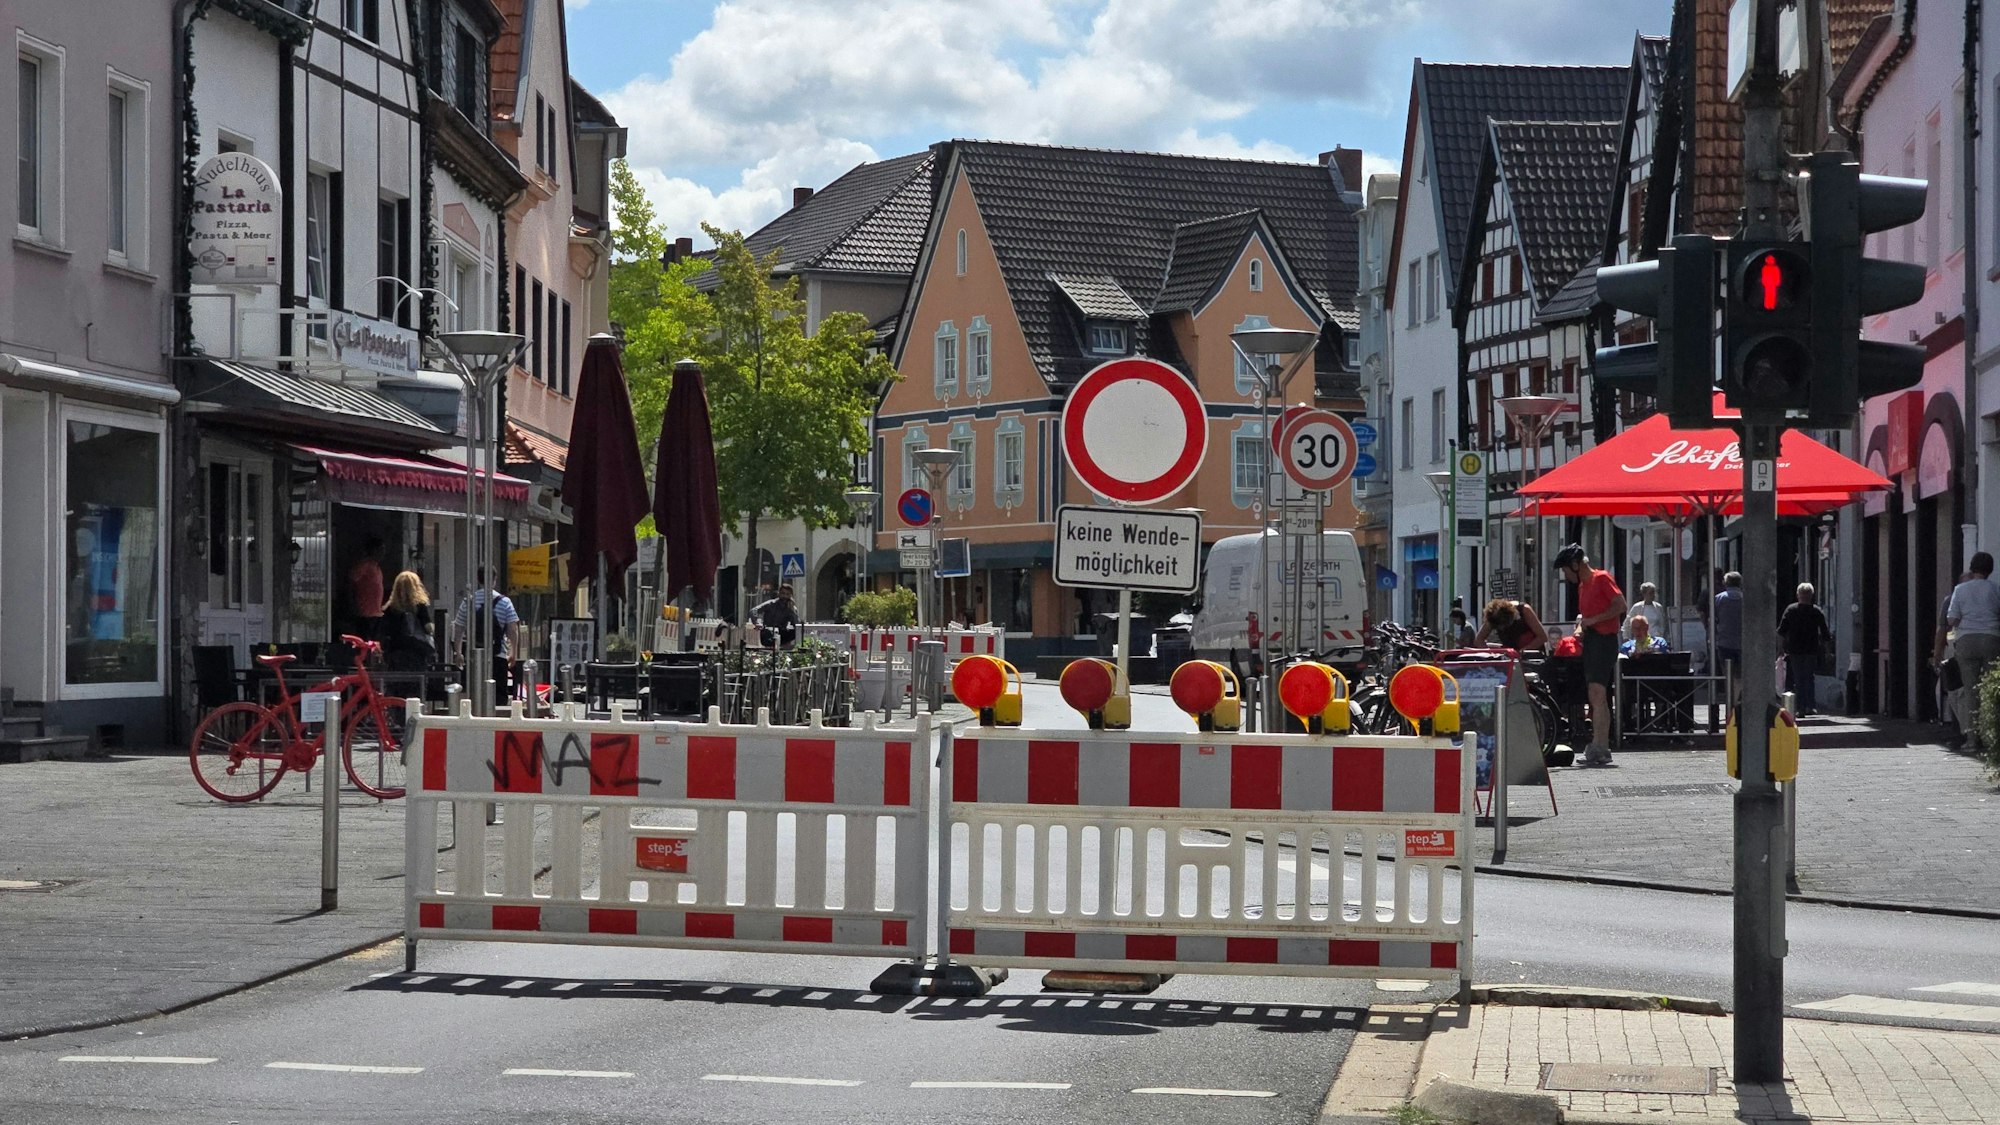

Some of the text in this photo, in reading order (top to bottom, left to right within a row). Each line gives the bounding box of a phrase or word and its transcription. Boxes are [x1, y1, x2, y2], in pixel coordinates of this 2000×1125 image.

[195, 157, 271, 192] Nudelhaus
[221, 185, 246, 199] La
[194, 200, 272, 213] Pastaria
[216, 220, 251, 229] Pizza,
[195, 231, 229, 240] Pasta
[231, 231, 240, 240] &
[1297, 434, 1340, 468] 30
[1621, 440, 1744, 473] Schäfe
[1067, 520, 1190, 546] keine Wende-
[1076, 551, 1178, 577] möglichkeit
[1285, 561, 1341, 571] LAZEATH
[1406, 834, 1430, 846] step
[648, 843, 673, 856] step
